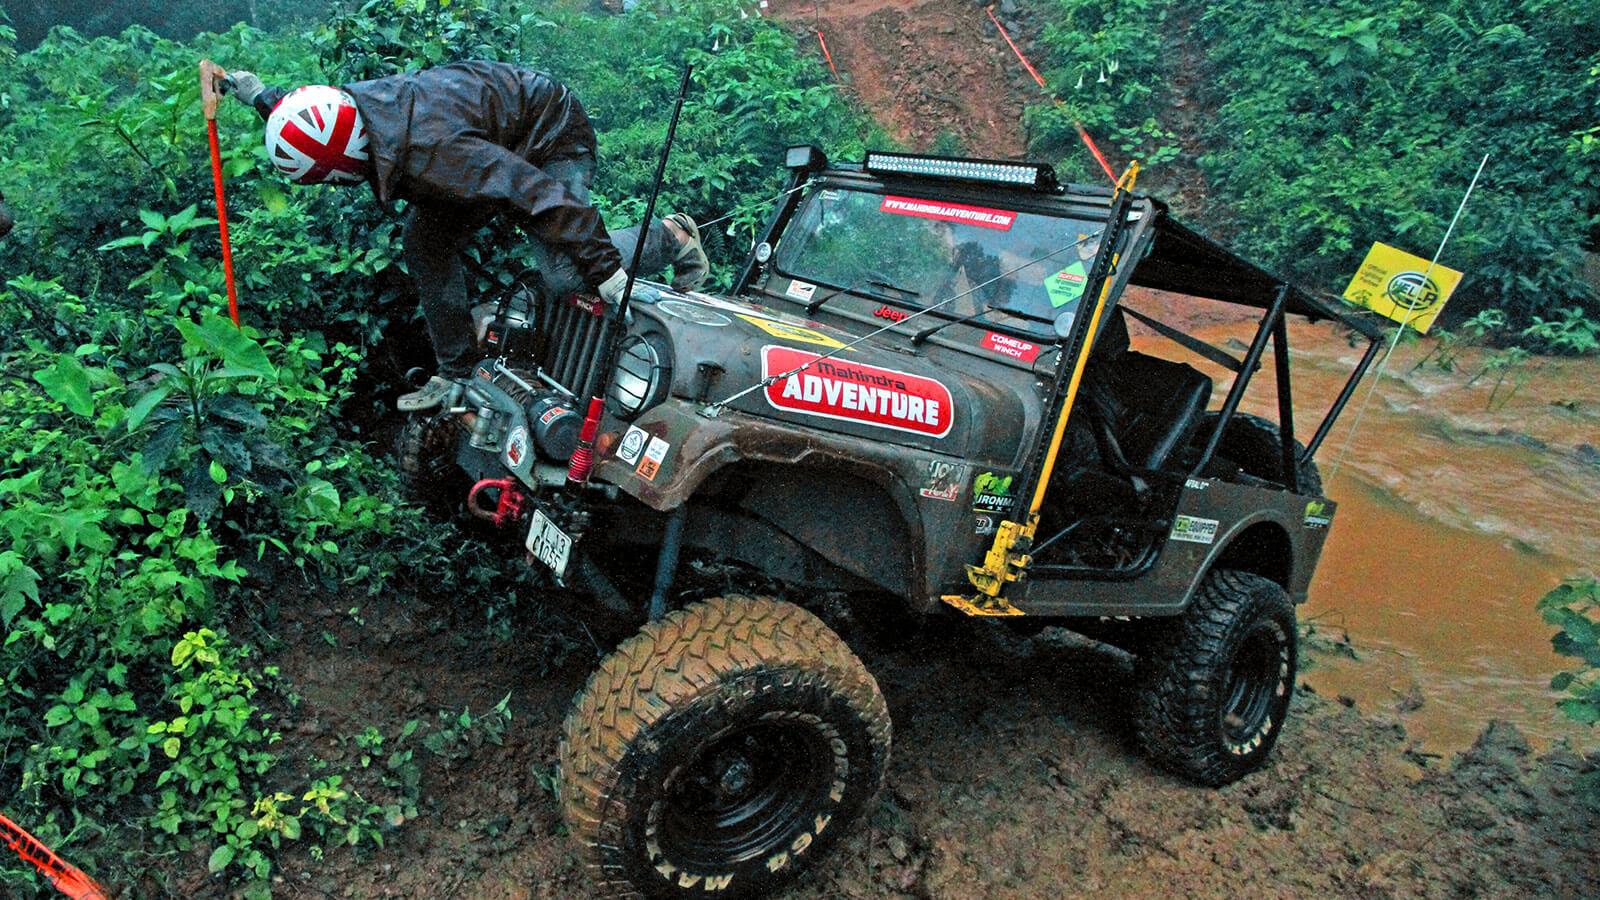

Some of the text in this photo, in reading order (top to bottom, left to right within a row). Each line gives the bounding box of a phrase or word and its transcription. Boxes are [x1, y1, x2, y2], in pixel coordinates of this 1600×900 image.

[885, 200, 1012, 225] WWW.MAHINDRAADVENTURE.COM
[873, 304, 909, 323] Jeep
[990, 333, 1033, 351] COMEUP
[994, 343, 1022, 358] WINCH
[782, 373, 940, 426] ADVENTURE
